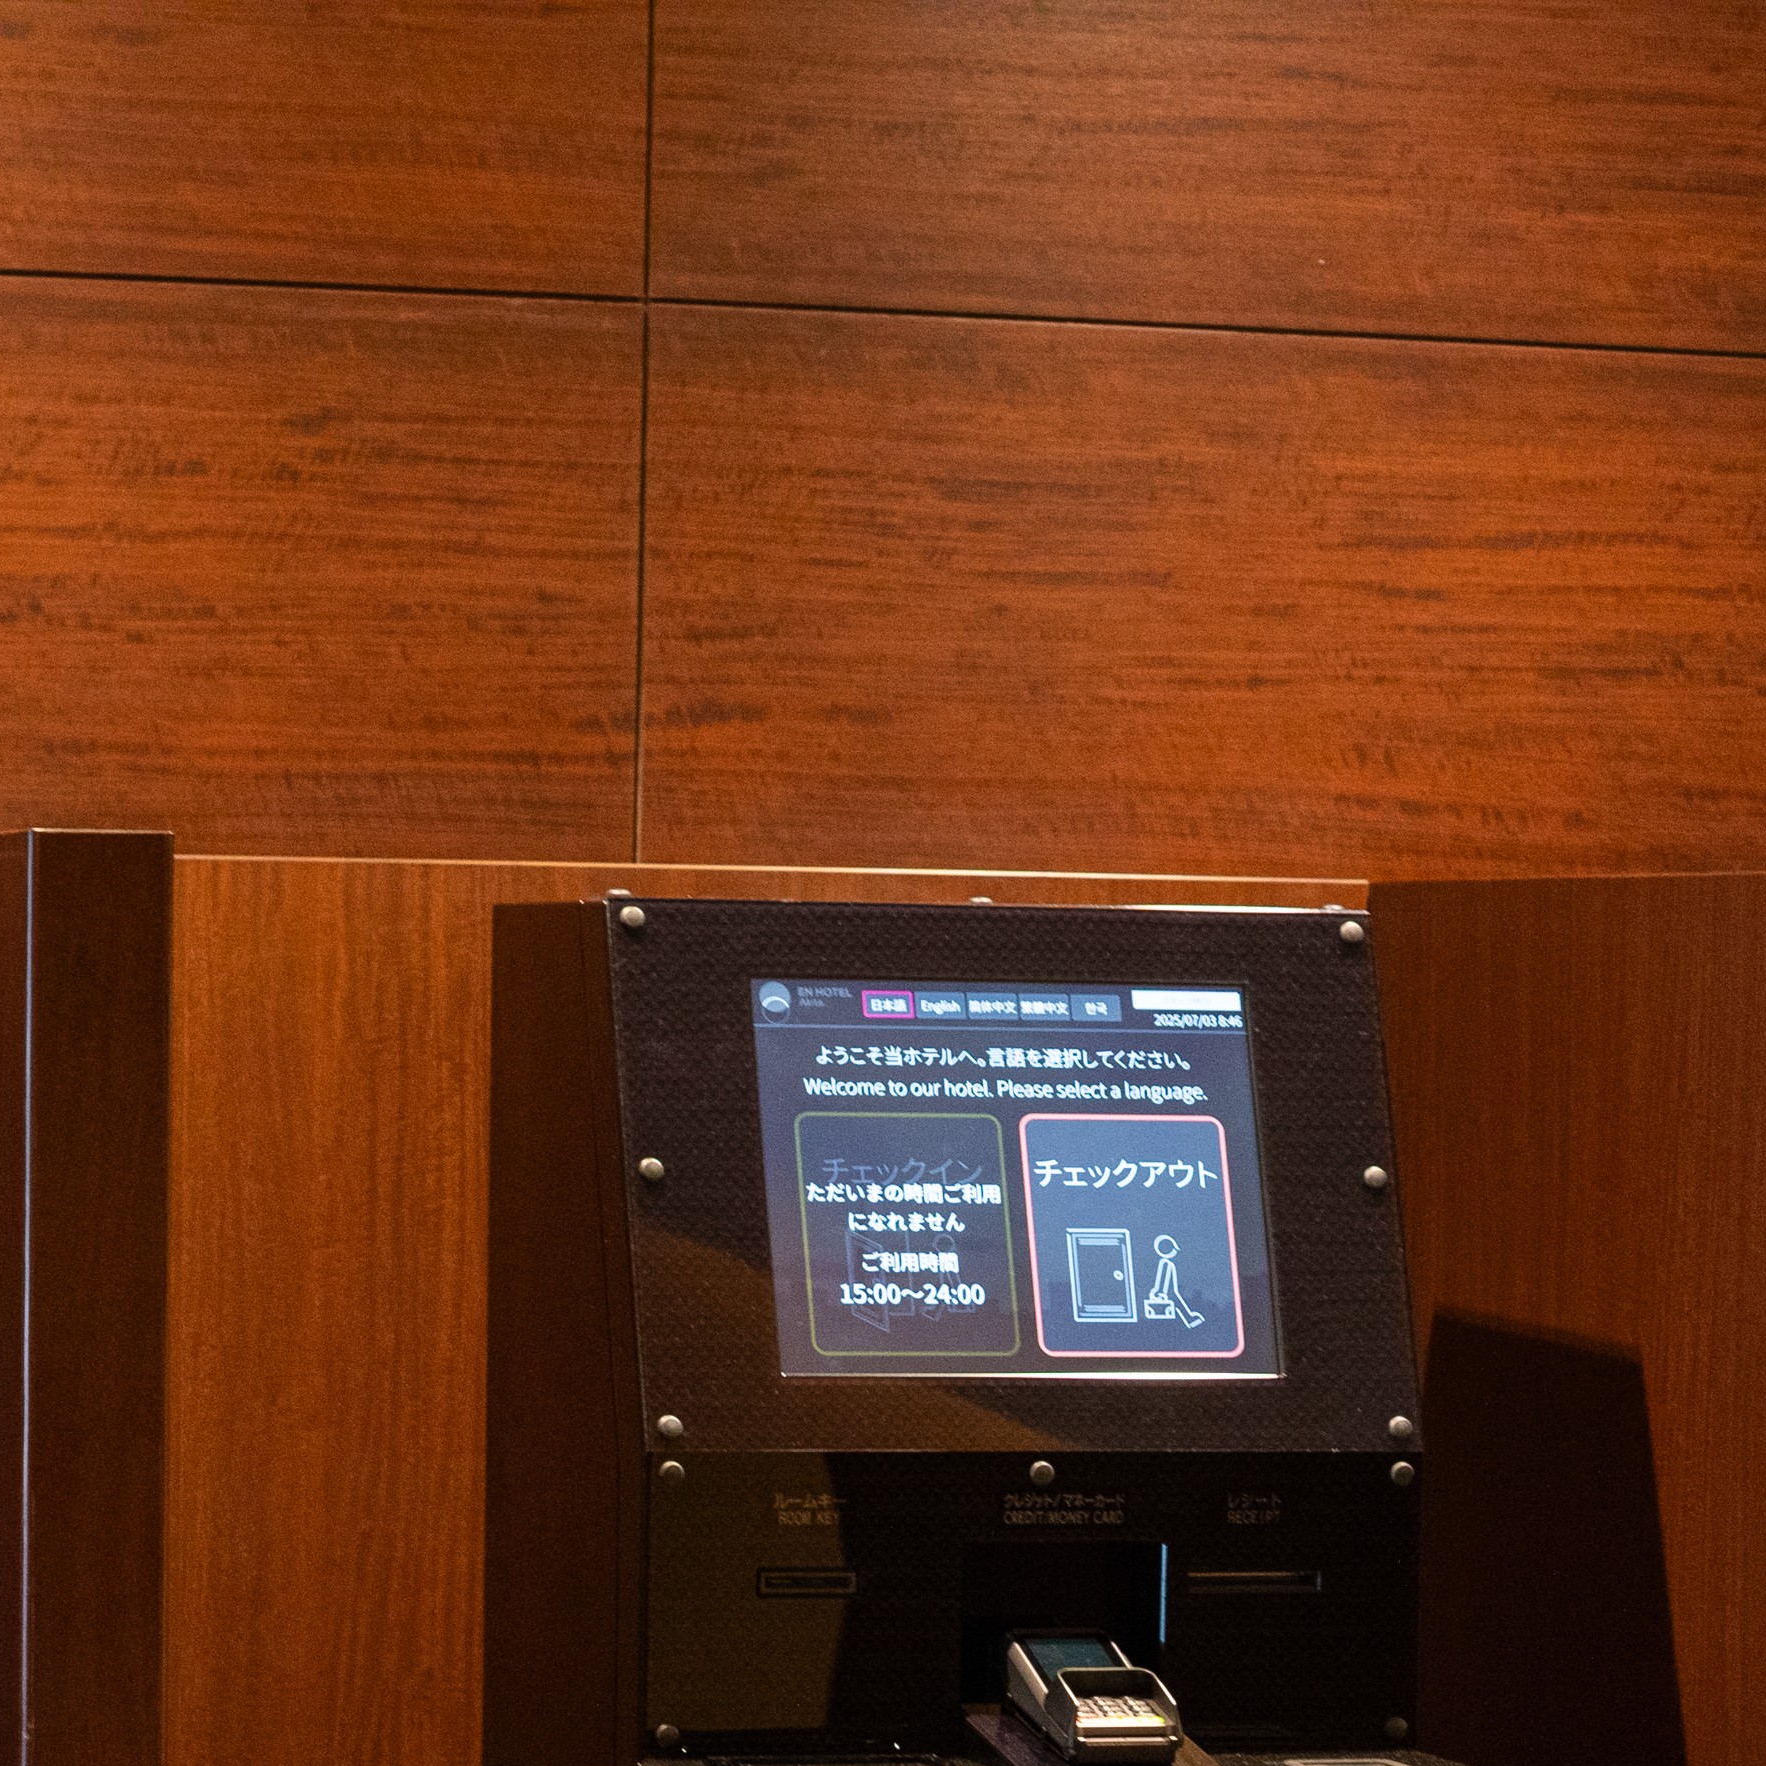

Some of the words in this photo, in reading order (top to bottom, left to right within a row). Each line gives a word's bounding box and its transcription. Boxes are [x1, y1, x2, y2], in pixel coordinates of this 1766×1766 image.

[870, 998, 907, 1013] 日本語
[921, 1000, 961, 1016] English
[1154, 1013, 1217, 1029] 2025/07/03
[815, 1046, 1191, 1070] ようこそ当ホテルへ。言語を選択してください。
[803, 1077, 886, 1097] Welcome
[888, 1079, 906, 1097] to
[909, 1081, 942, 1097] our
[944, 1078, 994, 1098] hotel.
[997, 1080, 1053, 1099] Please
[1056, 1080, 1108, 1099] select
[1110, 1085, 1121, 1099] a
[1124, 1081, 1208, 1105] language.
[821, 1157, 983, 1184] チェックイン
[1033, 1158, 1218, 1189] チェックアウト
[805, 1182, 1002, 1205] ただいまの時間ご利用
[848, 1211, 966, 1232] になれません
[861, 1252, 960, 1274] ご利用時間
[773, 1492, 848, 1509] ルームキー
[1227, 1491, 1282, 1508] レシート
[778, 1510, 812, 1526] ROOM
[1093, 1510, 1124, 1525] CARD
[1226, 1509, 1281, 1525] RECEIPT
